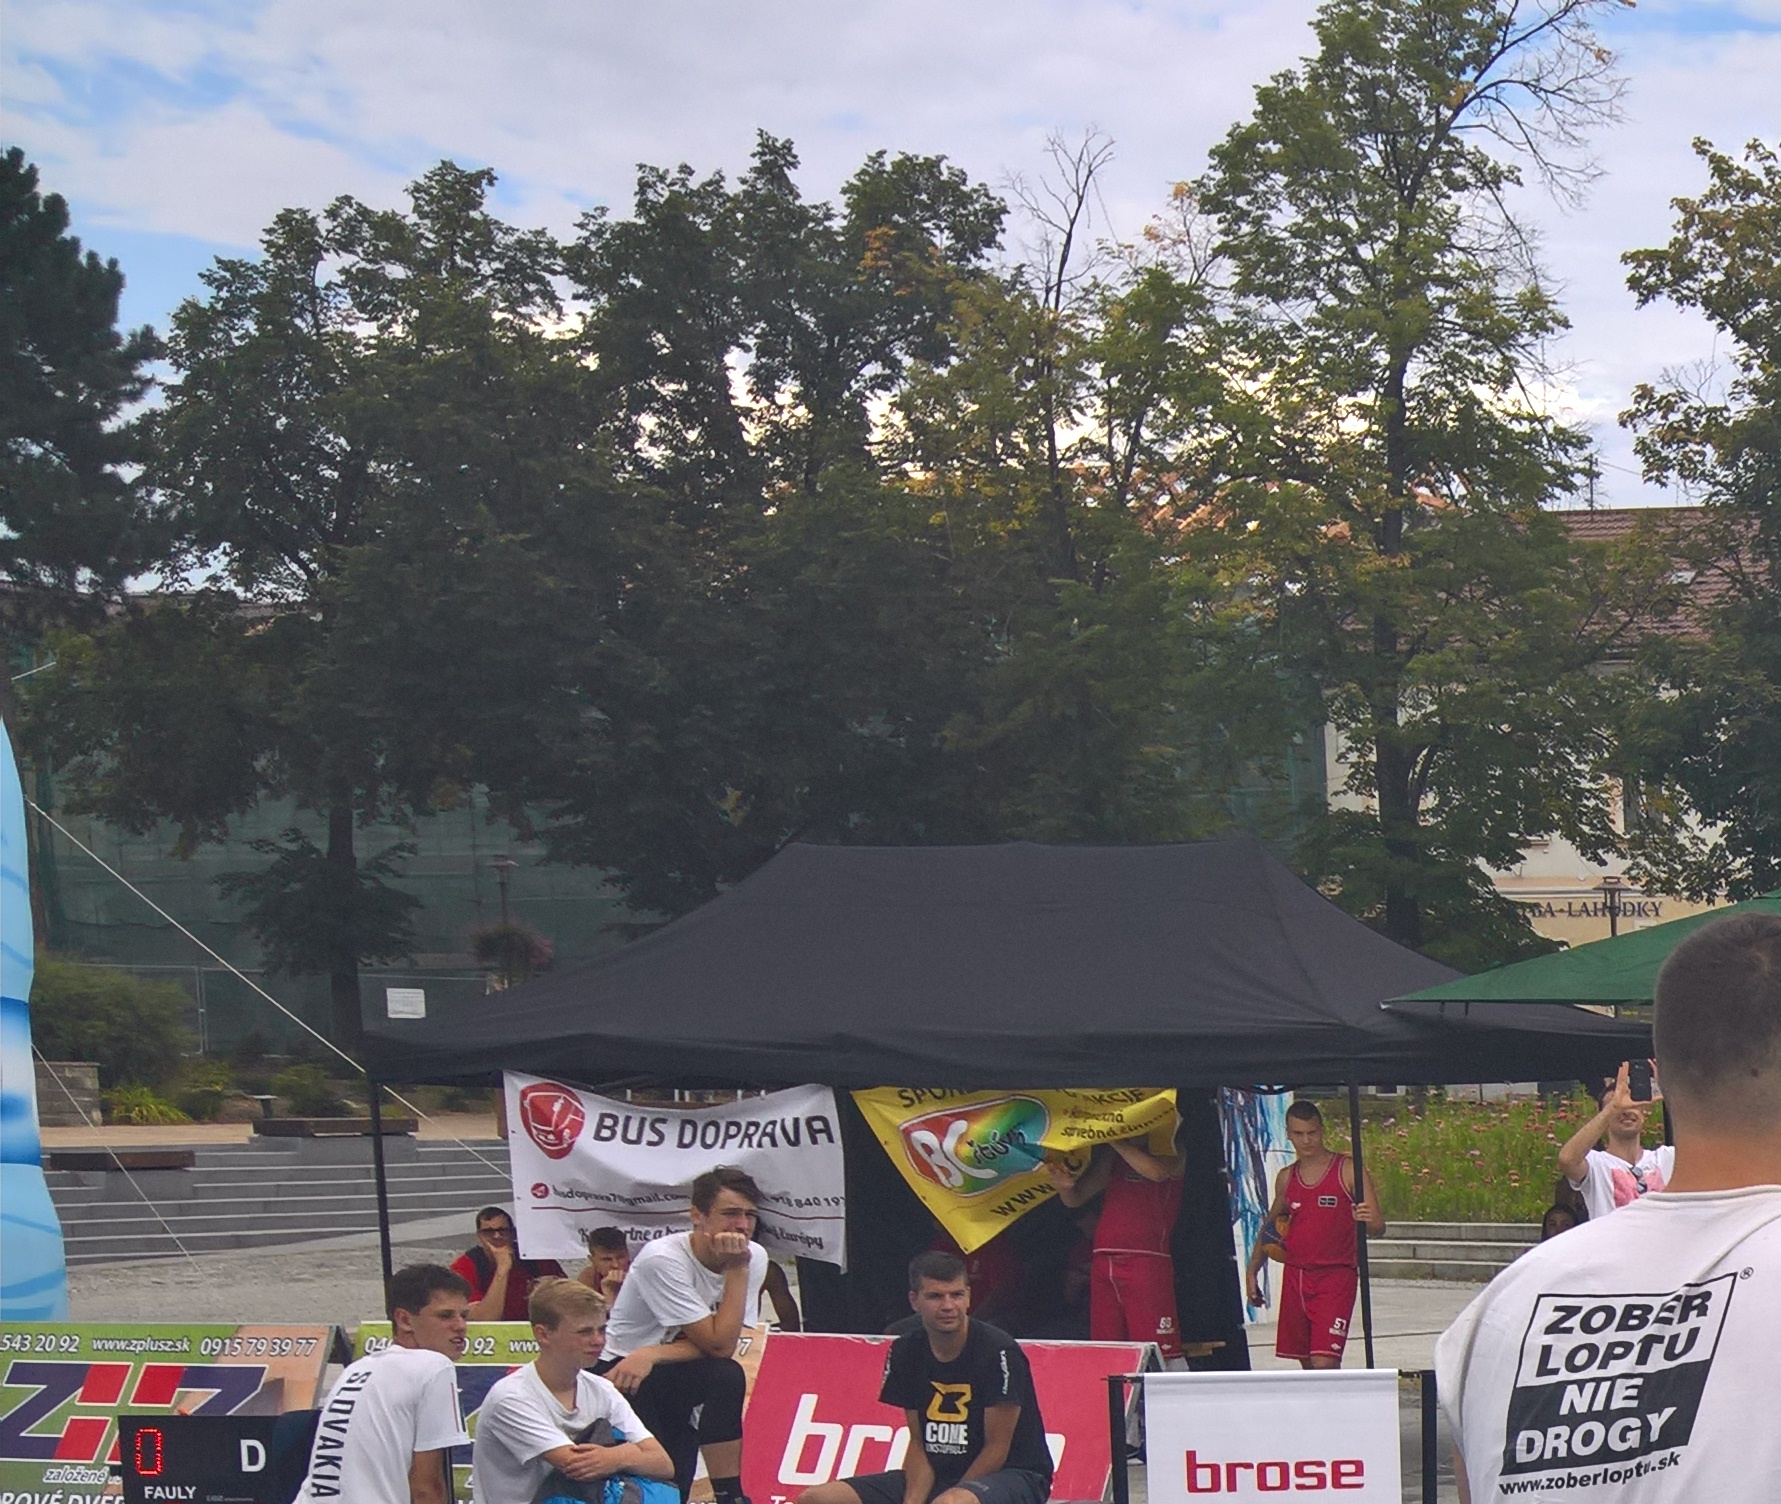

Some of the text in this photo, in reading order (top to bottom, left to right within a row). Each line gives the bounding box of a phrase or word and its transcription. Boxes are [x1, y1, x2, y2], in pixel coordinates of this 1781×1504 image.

[593, 1112, 834, 1150] BUS DOPRAVA
[1544, 1290, 1713, 1336] ZOBER
[35, 1334, 55, 1352] 20
[57, 1334, 81, 1353] 92
[92, 1336, 192, 1354] www.zplusz.sk
[200, 1338, 242, 1356] 0915
[245, 1338, 266, 1357] 79
[268, 1338, 292, 1357] 39
[293, 1338, 319, 1357] 77
[474, 1337, 495, 1356] 92
[1535, 1326, 1700, 1377] LOPTU
[1559, 1377, 1644, 1416] NIE
[135, 1427, 266, 1476] 0 D
[311, 1370, 372, 1498] SLOVAKIA
[1516, 1406, 1677, 1464] DROGY
[43, 1466, 109, 1485] založené
[144, 1486, 196, 1499] FAULY
[1186, 1450, 1365, 1494] brose
[1499, 1452, 1681, 1495] www.zoberloptu.sk
